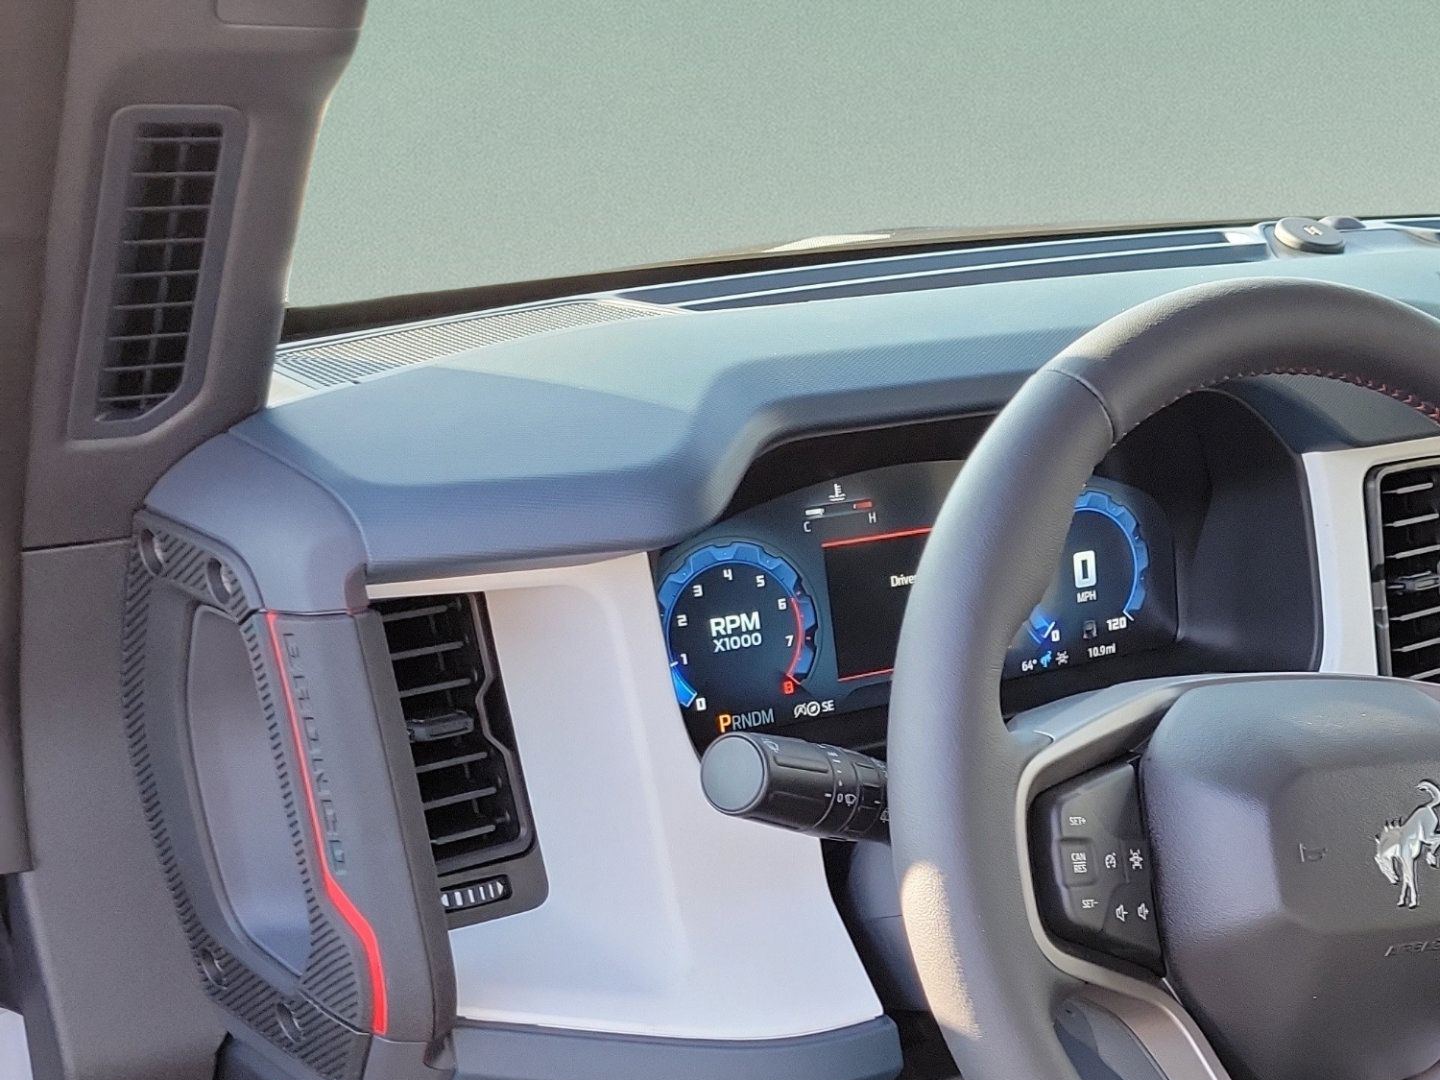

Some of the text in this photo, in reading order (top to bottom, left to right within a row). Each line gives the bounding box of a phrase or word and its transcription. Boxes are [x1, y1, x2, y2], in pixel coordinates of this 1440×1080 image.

[868, 511, 877, 523] H
[803, 521, 812, 532] C
[723, 568, 733, 580] 4
[1073, 550, 1097, 588] 0
[755, 575, 765, 587] 5
[890, 574, 917, 588] Drive
[693, 585, 704, 597] 3
[1076, 590, 1097, 603] MPH
[777, 598, 787, 610] 6
[676, 614, 688, 627] 2
[710, 611, 761, 637] RPM
[1106, 616, 1127, 631] 120
[785, 635, 794, 647] 7
[1051, 629, 1060, 642] 0
[713, 632, 762, 653] X1000
[680, 653, 688, 665] 1
[783, 681, 794, 694] 8
[696, 697, 707, 711] 0
[1071, 852, 1086, 862] CAN
[1073, 864, 1088, 873] RES
